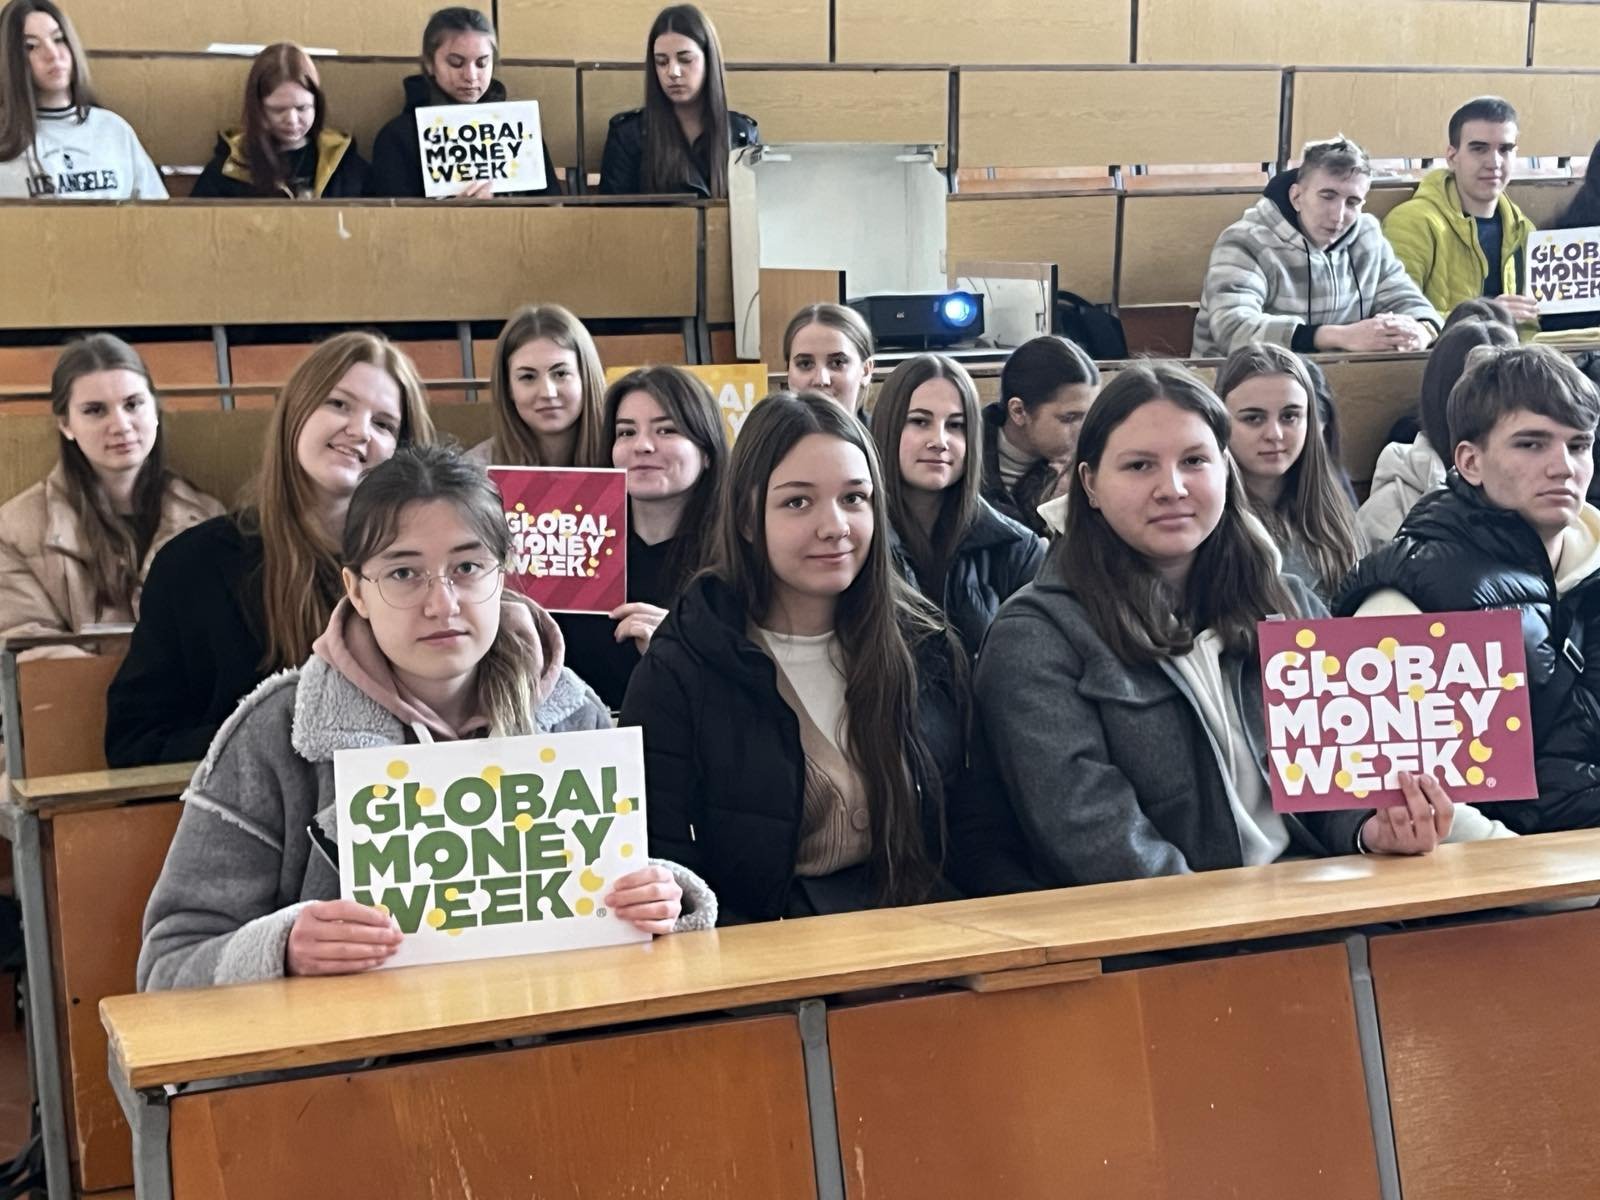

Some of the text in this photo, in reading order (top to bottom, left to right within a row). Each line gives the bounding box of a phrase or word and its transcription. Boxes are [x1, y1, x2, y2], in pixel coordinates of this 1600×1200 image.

[424, 121, 533, 144] GLOBAL
[425, 141, 522, 164] MONEY
[58, 169, 117, 194] ANGELES
[427, 161, 508, 183] WEEK
[505, 511, 616, 537] GLOBAL
[1265, 641, 1525, 699] GLOBAL
[1268, 689, 1500, 747] MONEY
[1270, 739, 1467, 796] WEEK
[350, 766, 639, 834] GLOBAL
[352, 815, 614, 887] MONEY
[352, 870, 574, 934] WEEK
